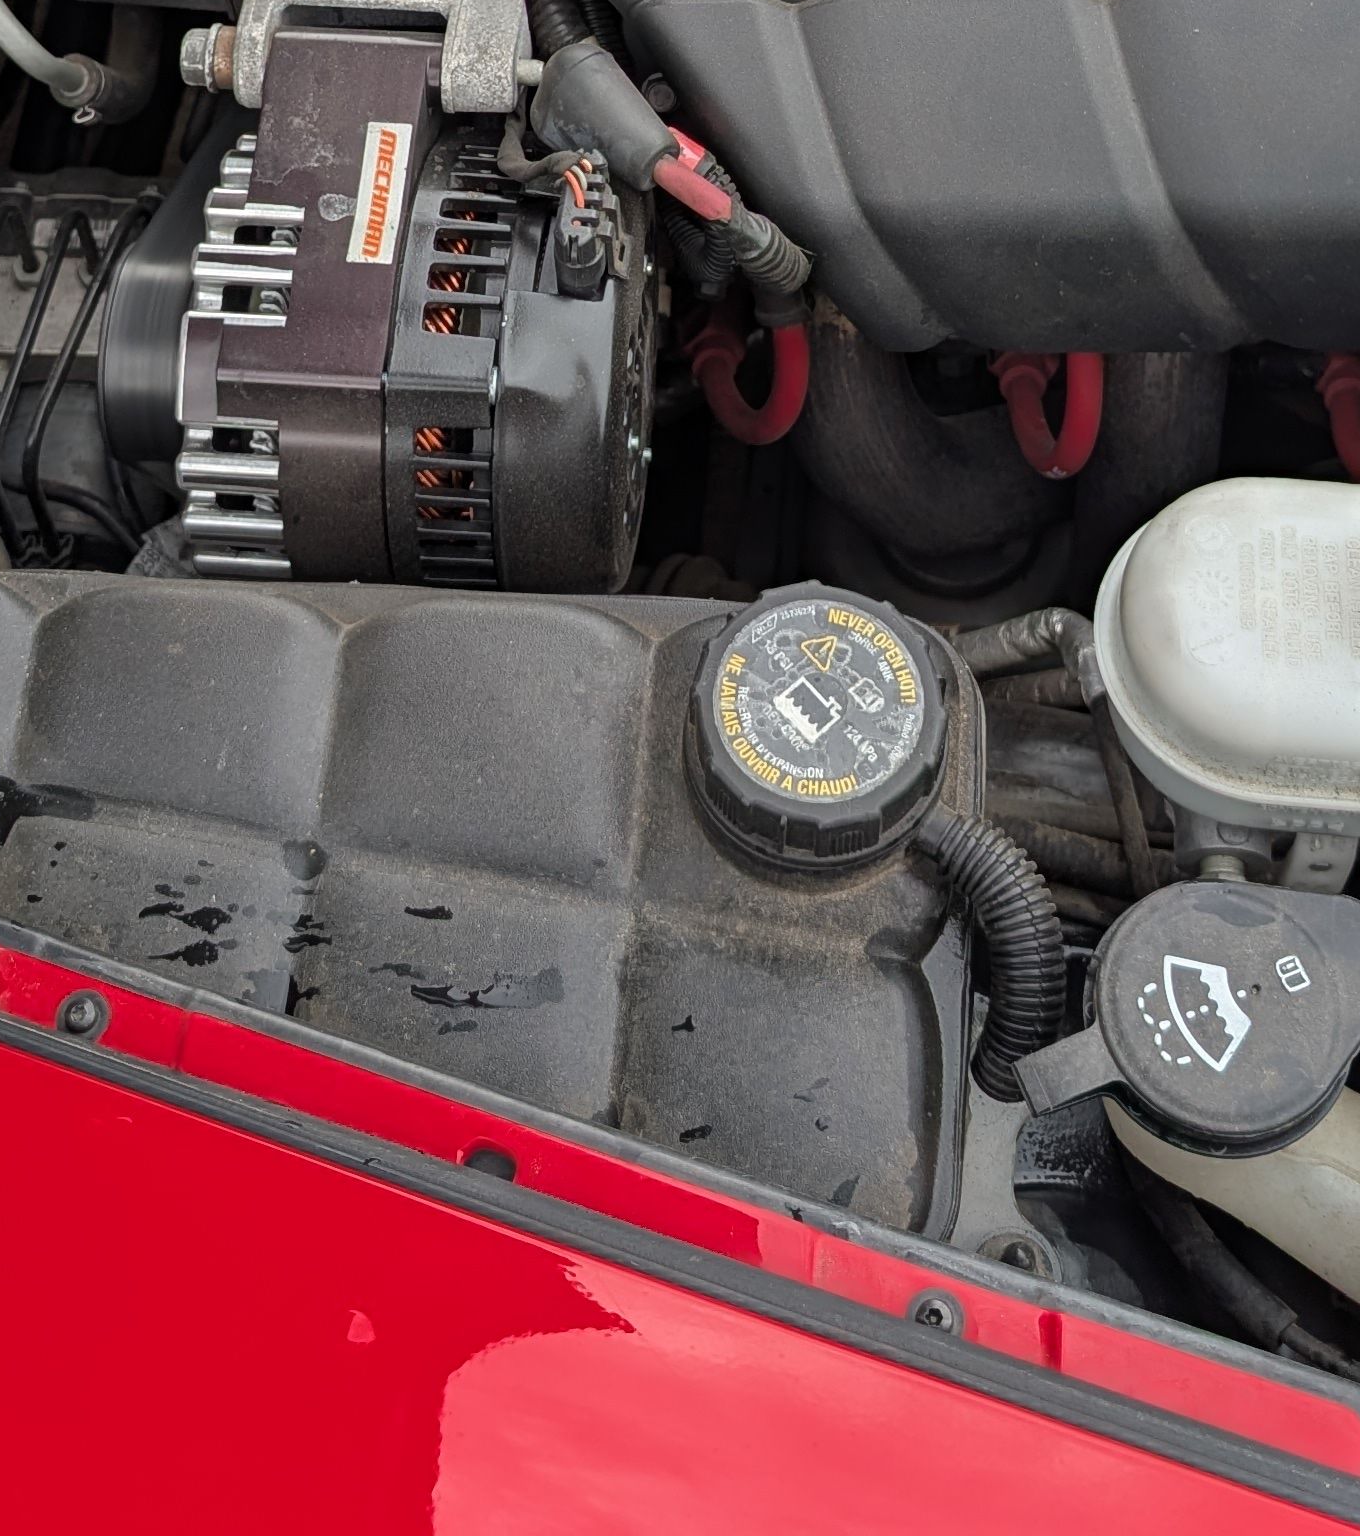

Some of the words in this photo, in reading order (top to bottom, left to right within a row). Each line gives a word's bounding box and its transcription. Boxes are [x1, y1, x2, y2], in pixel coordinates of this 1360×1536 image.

[725, 652, 747, 677] NE
[773, 650, 794, 672] PSI
[827, 607, 876, 638] NEVER
[873, 631, 907, 670] OPEN
[895, 668, 918, 705] HOT!
[731, 736, 782, 785] OUVRIR
[796, 773, 858, 797] CHAUD!
